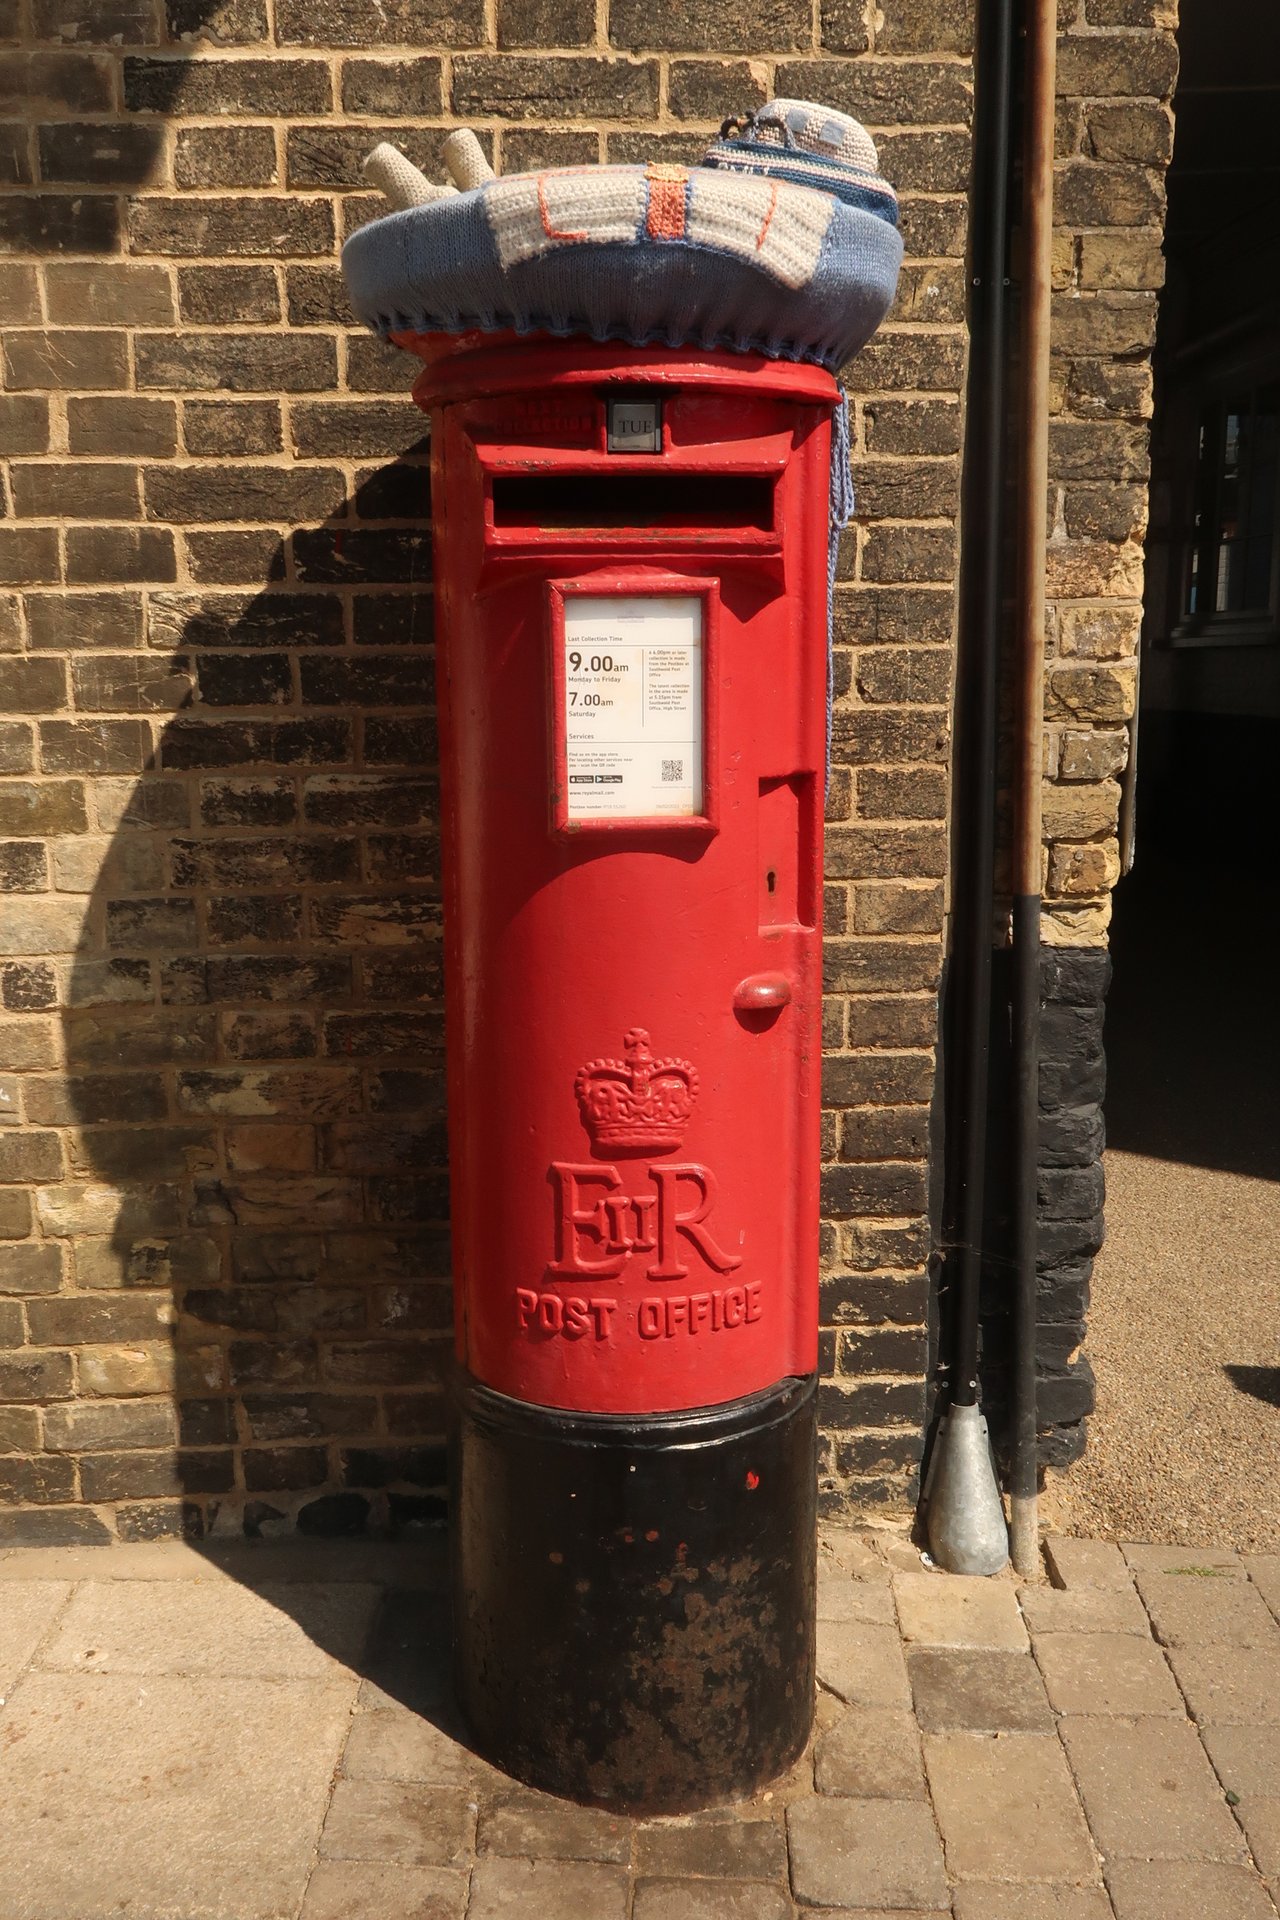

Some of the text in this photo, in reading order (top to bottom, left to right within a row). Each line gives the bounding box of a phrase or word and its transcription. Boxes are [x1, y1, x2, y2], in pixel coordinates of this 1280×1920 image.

[618, 420, 652, 434] TUE
[569, 652, 629, 672] 9.00am
[568, 692, 614, 706] 7.00am
[516, 1279, 763, 1340] POST OFFICE
